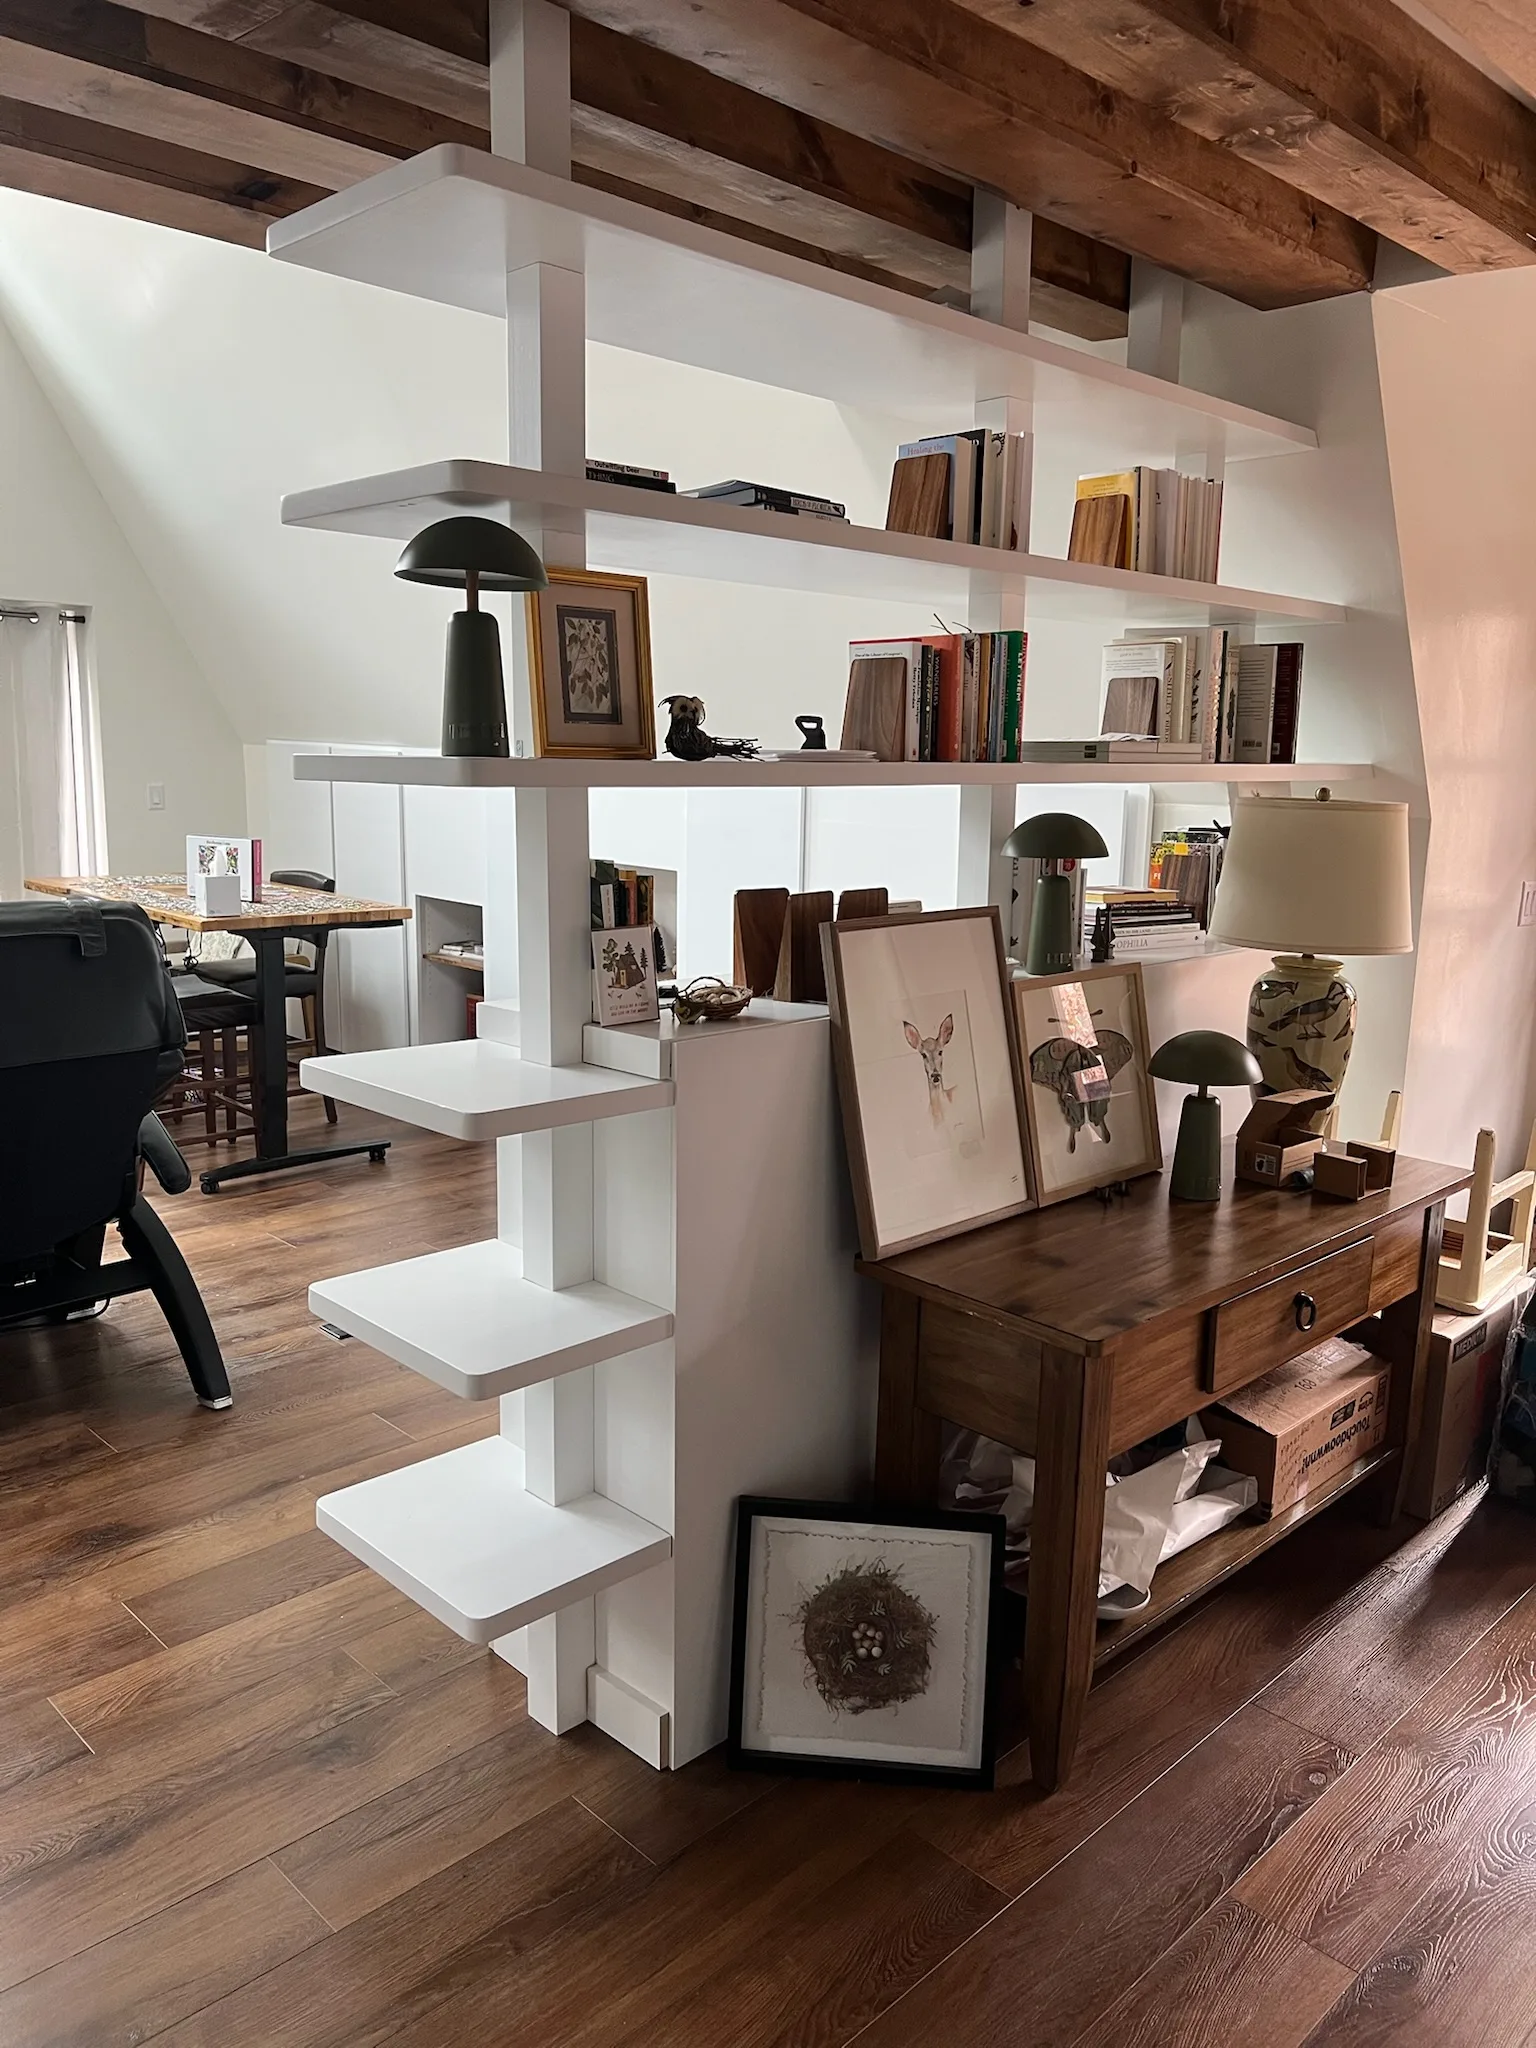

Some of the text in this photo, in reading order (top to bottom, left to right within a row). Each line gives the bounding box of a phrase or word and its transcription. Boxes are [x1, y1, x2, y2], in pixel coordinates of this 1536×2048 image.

[907, 446, 932, 456] Healing
[594, 460, 640, 474] Outwitting Deer
